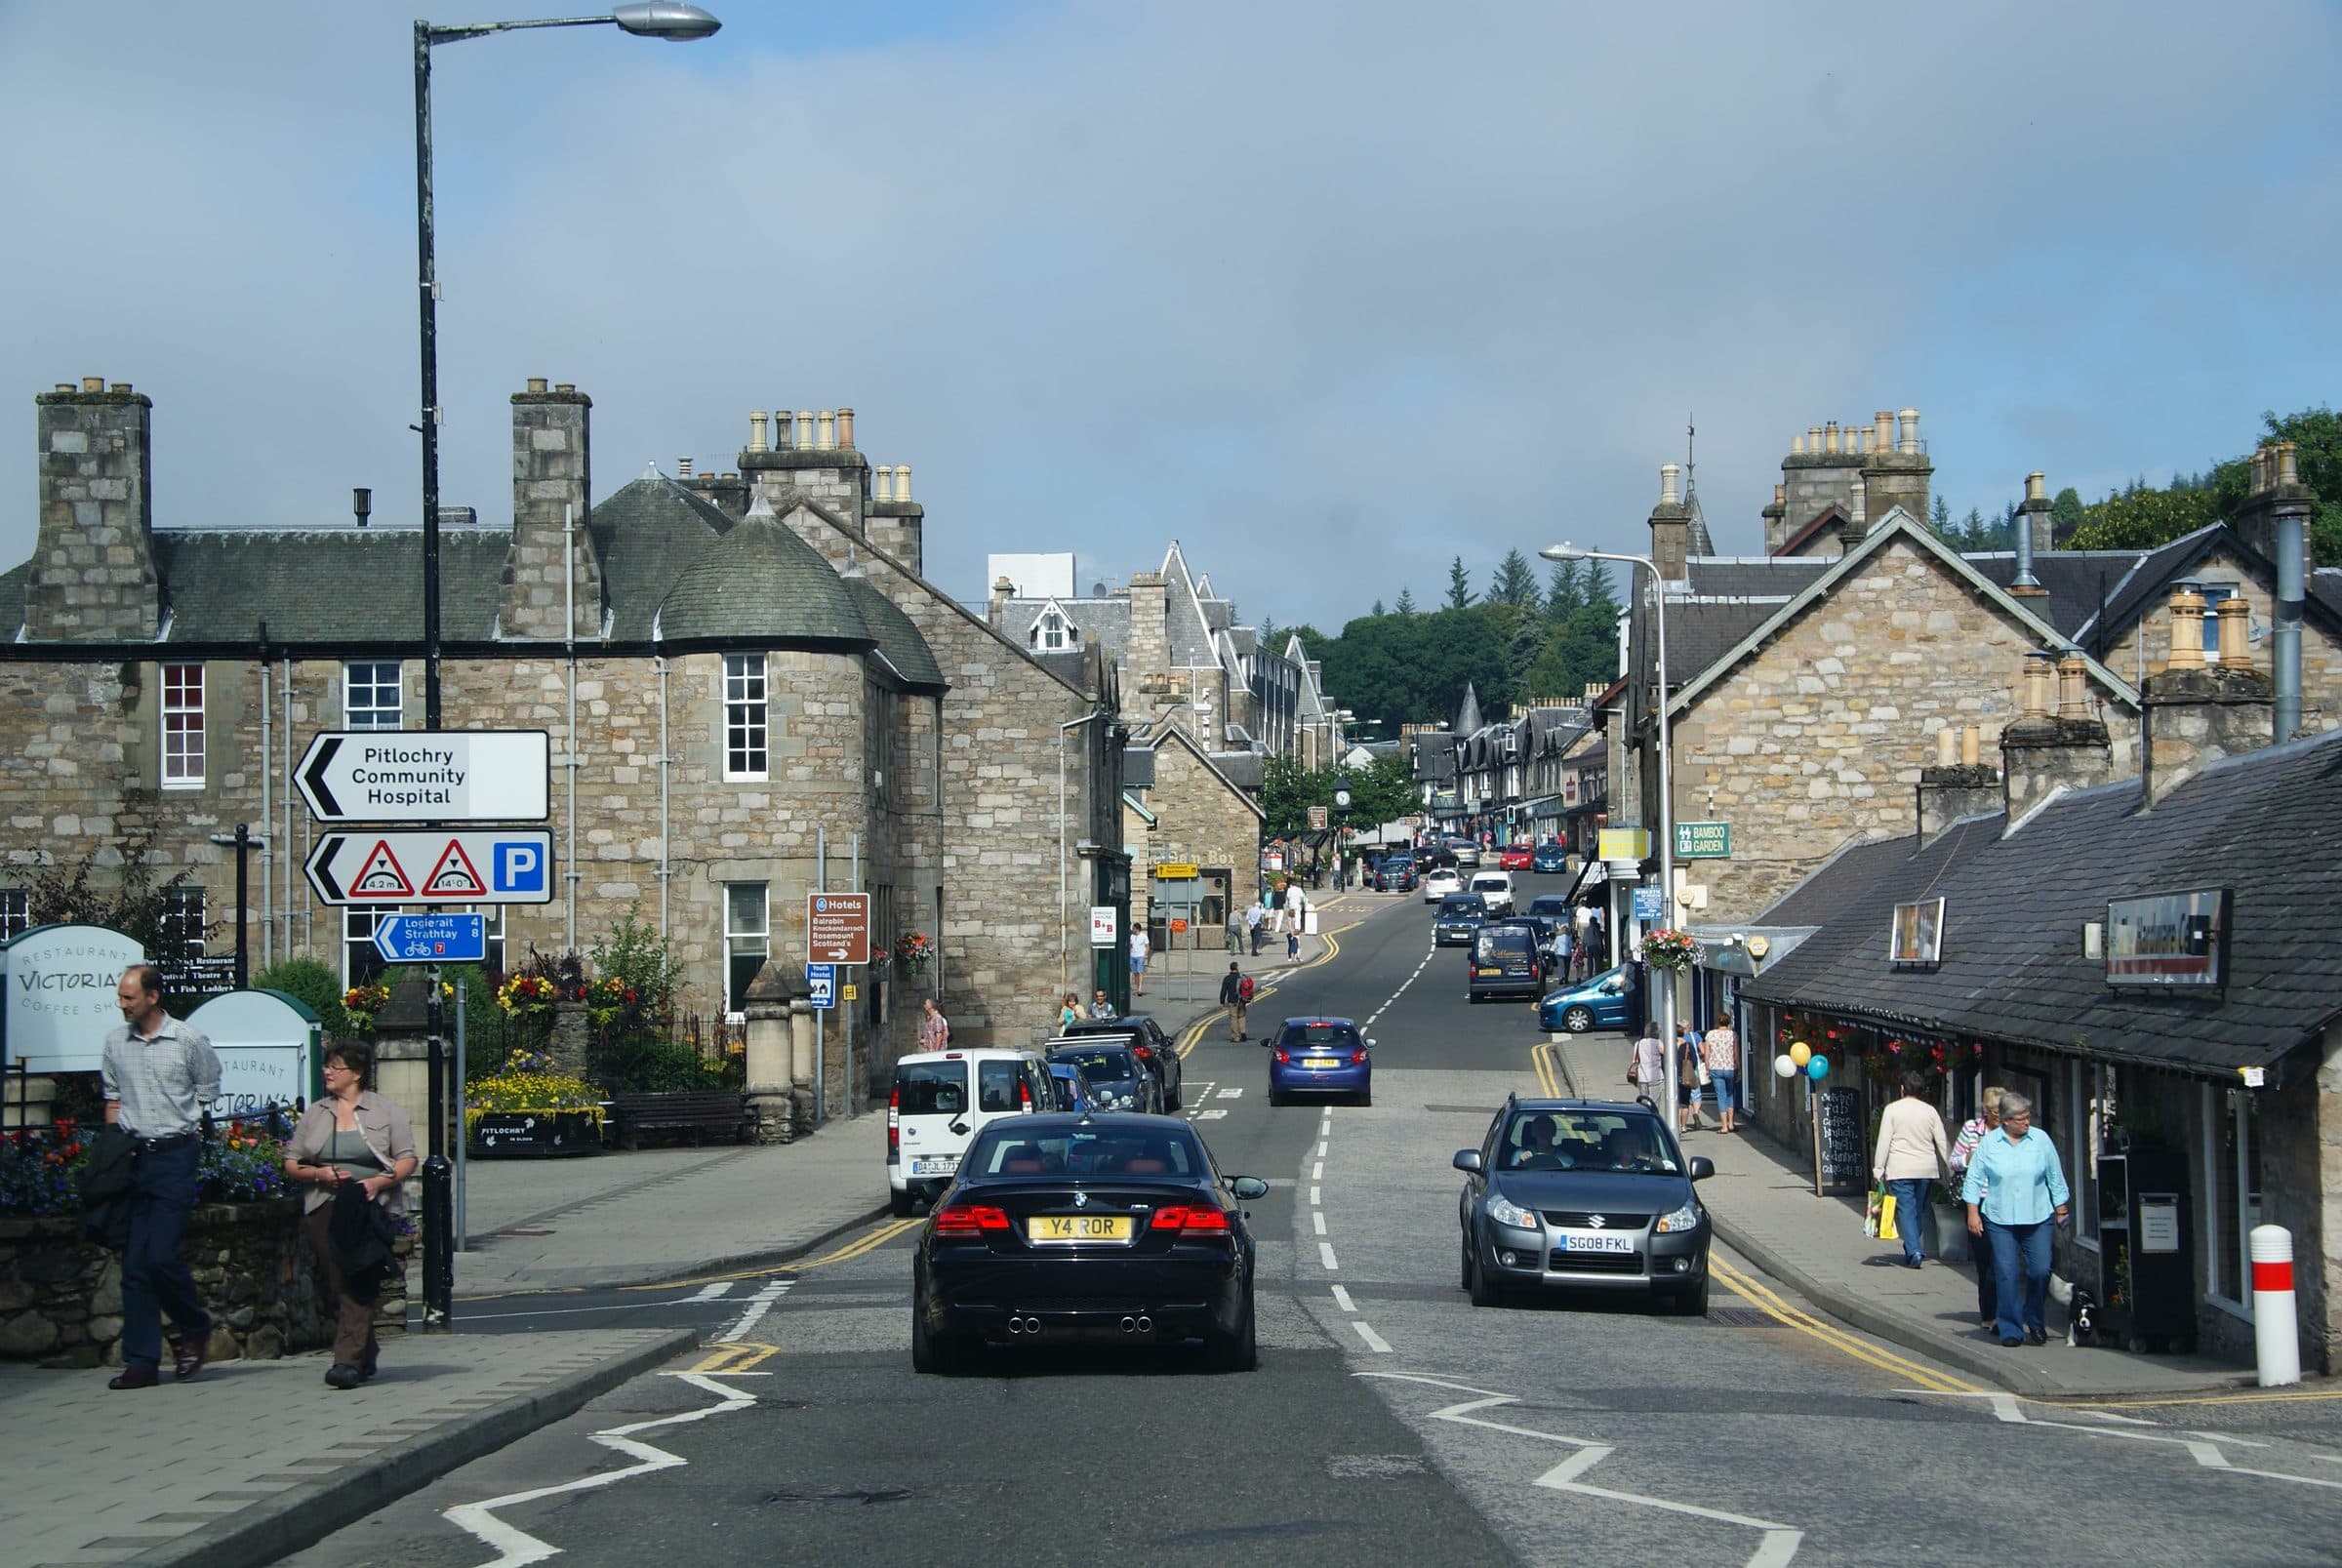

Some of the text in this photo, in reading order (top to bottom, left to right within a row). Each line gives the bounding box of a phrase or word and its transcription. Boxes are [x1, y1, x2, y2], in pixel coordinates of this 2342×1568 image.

[365, 747, 453, 766] Pitlochry
[352, 768, 464, 786] Community
[368, 788, 451, 806] Hospital
[1693, 826, 1725, 839] BAMBOO
[1693, 840, 1724, 852] GARDEN
[1208, 850, 1235, 864] Box
[505, 848, 537, 887] P
[829, 900, 862, 909] Hotels
[405, 918, 453, 930] Logierait
[405, 929, 478, 940] Strathtay 8
[22, 946, 127, 965] RESTAURANT
[19, 971, 122, 992] VICTORIA'
[160, 972, 186, 981] estival
[21, 998, 79, 1015] COFFEE
[224, 1061, 284, 1080] TAURANT
[1052, 1219, 1113, 1234] Y4 ROR
[1569, 1237, 1632, 1251] SG08 FKL
